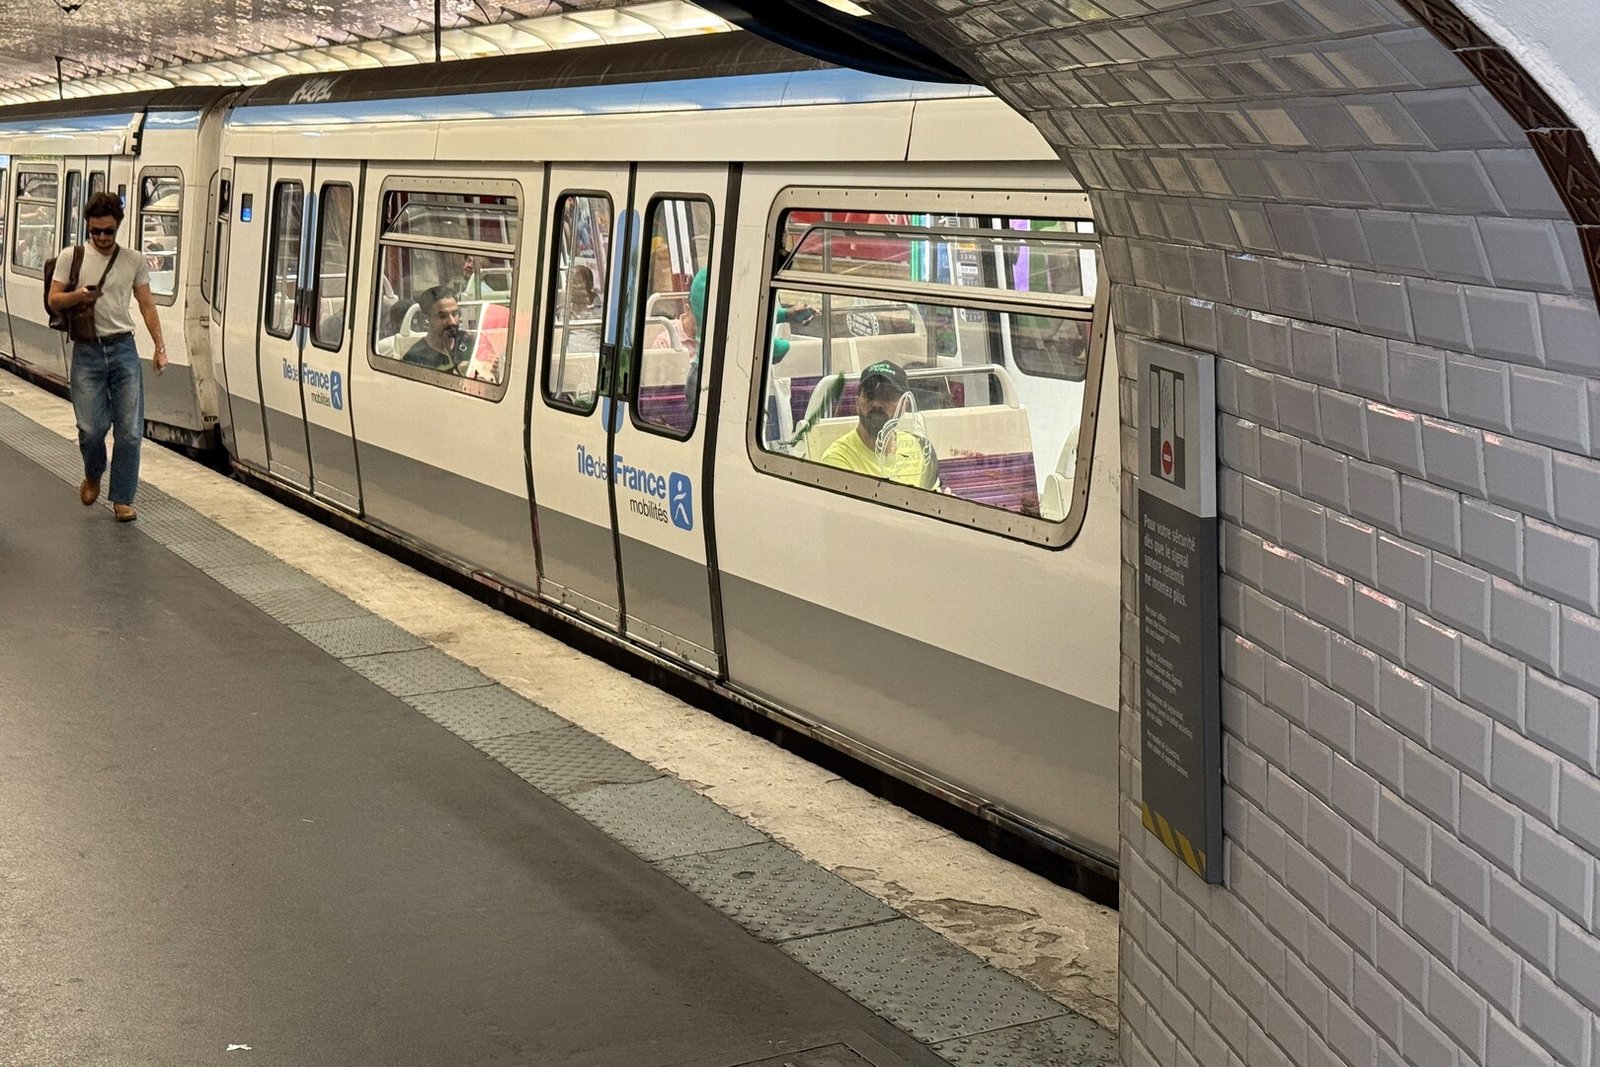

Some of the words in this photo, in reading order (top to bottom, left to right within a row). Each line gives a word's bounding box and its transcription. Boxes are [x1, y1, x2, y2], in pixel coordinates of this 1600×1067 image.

[302, 362, 330, 390] France
[613, 454, 666, 500] France
[629, 498, 669, 524] mobilités
[1143, 513, 1156, 532] Pour
[1156, 523, 1171, 540] votre
[1172, 528, 1195, 552] sécurité
[1144, 554, 1162, 573] sonore
[1171, 547, 1189, 568] signal
[1152, 577, 1172, 599] montez
